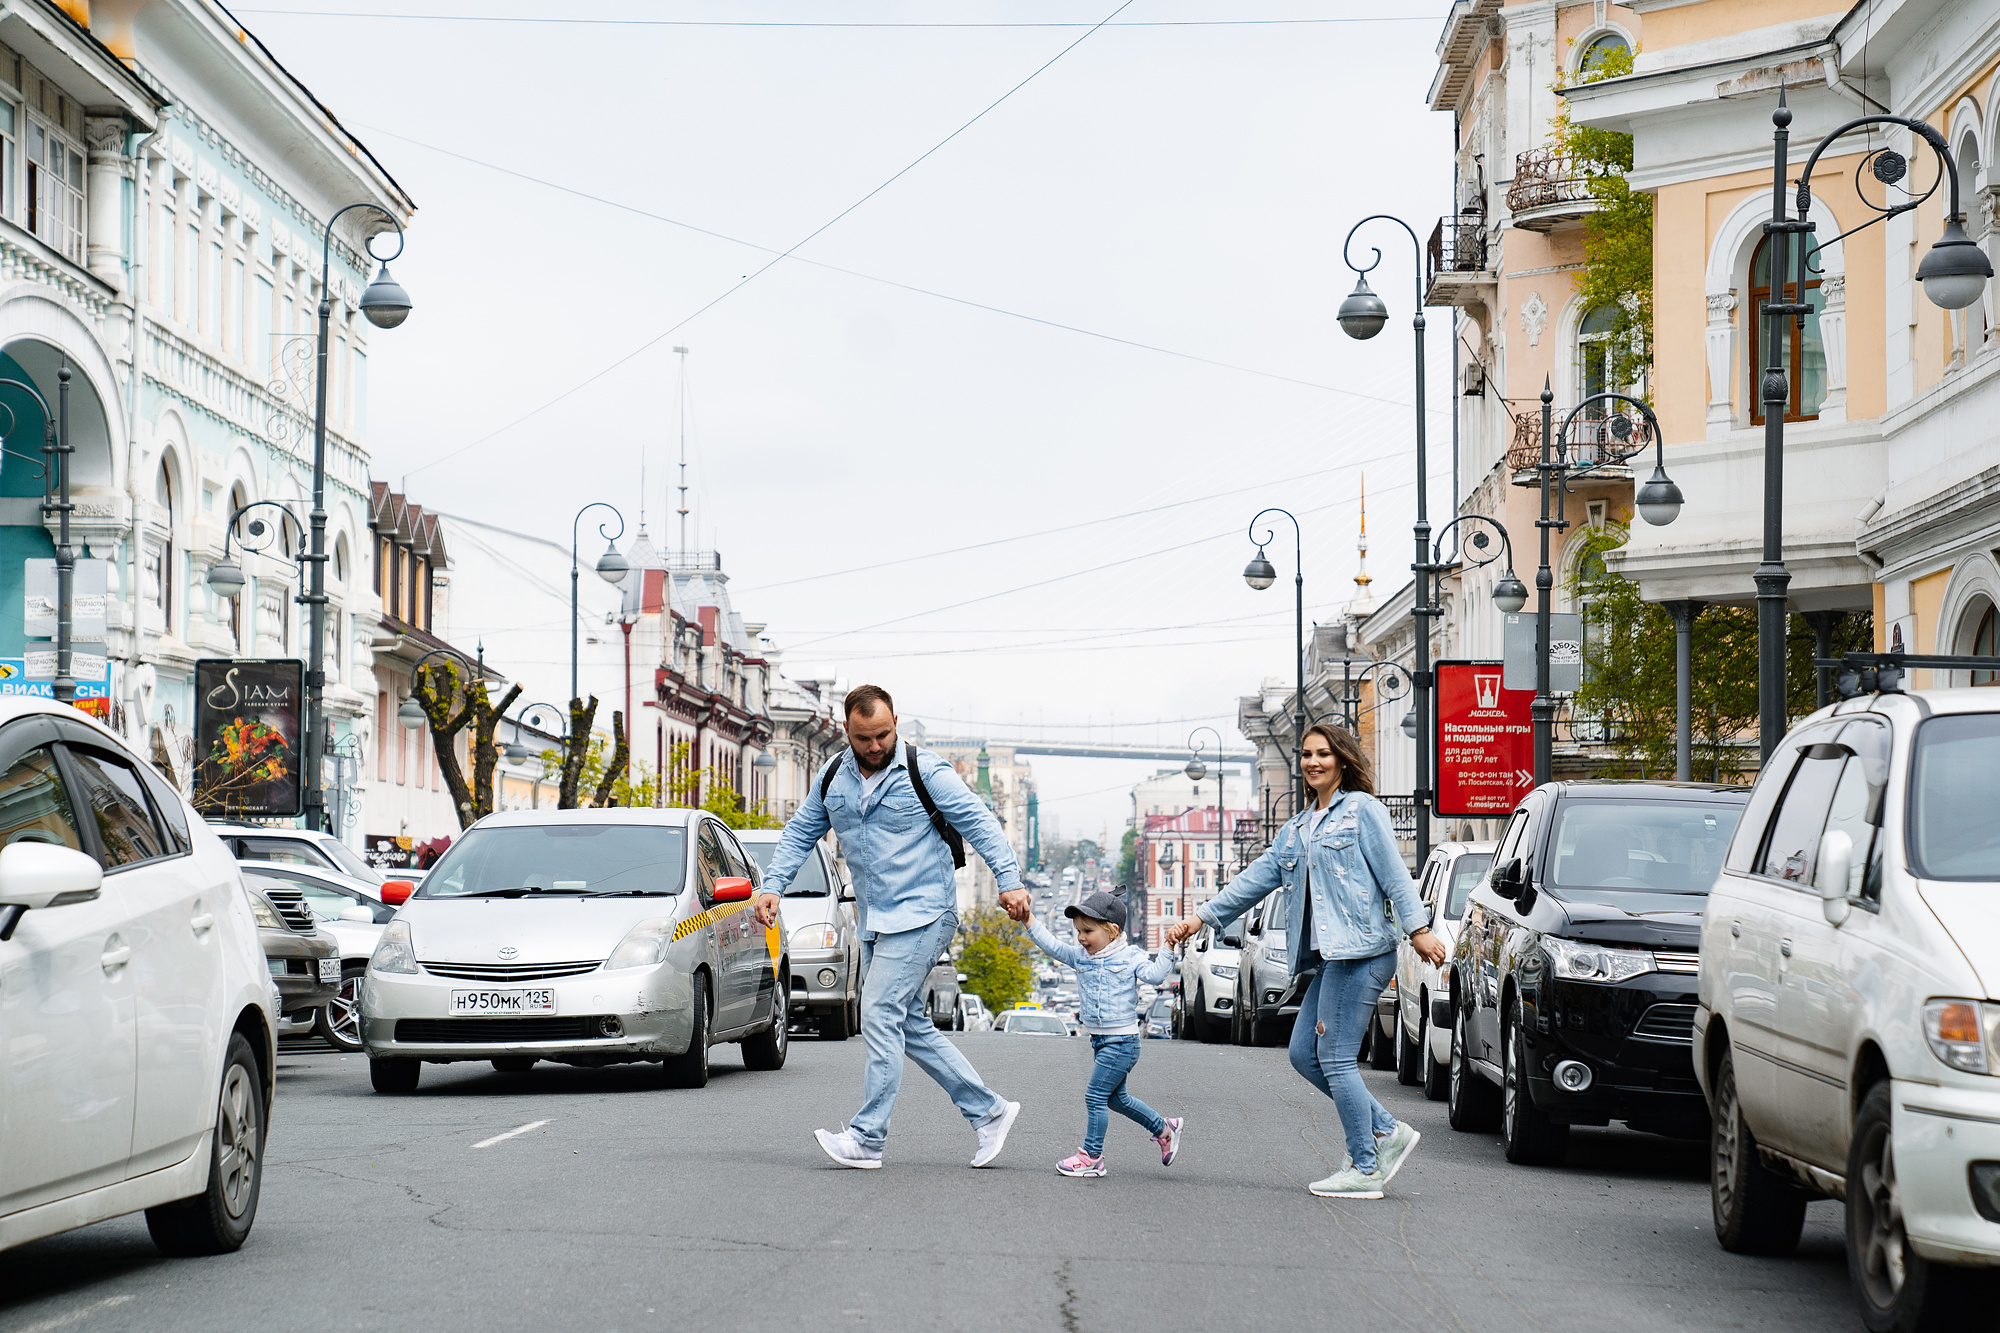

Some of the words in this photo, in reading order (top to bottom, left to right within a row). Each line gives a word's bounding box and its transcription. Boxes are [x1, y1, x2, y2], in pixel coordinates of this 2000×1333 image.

[1549, 642, 1579, 655] РАБОТА
[1468, 709, 1508, 717] МОСИГРА
[1444, 722, 1504, 733] Настольные
[1505, 725, 1531, 735] игры
[1444, 734, 1451, 742] и
[1453, 734, 1495, 744] подарки
[1445, 747, 1460, 755] для
[1461, 746, 1485, 755] детей
[1455, 755, 1461, 763] 3
[1461, 756, 1472, 764] до
[1473, 755, 1483, 763] 99
[1499, 771, 1514, 779] там
[457, 993, 521, 1009] Н950МК
[525, 991, 549, 1003] 125
